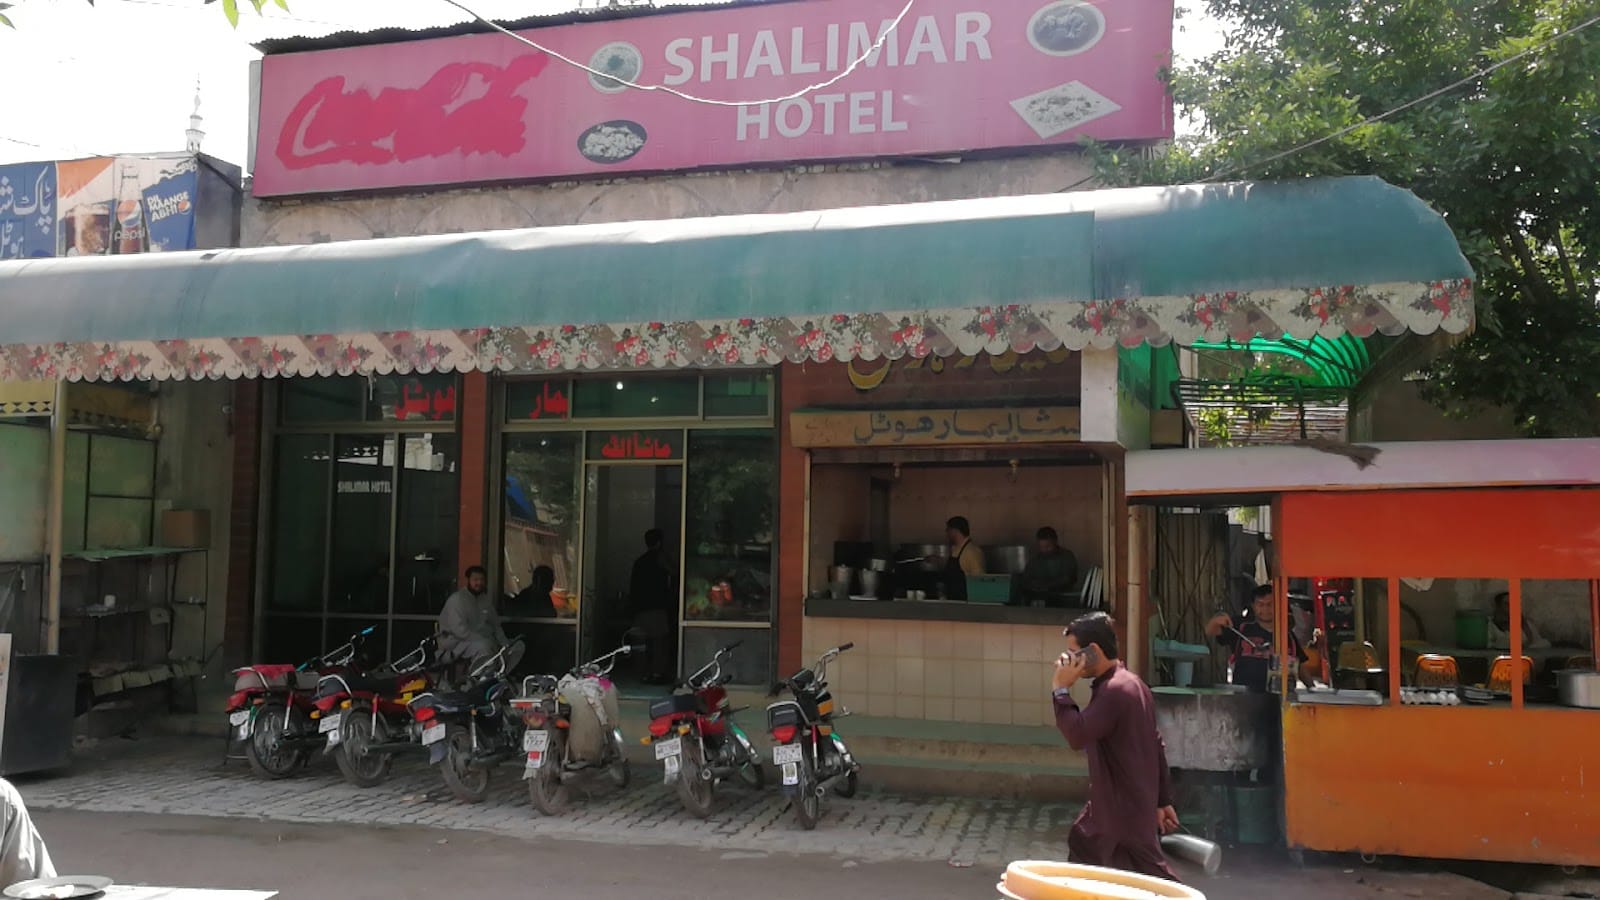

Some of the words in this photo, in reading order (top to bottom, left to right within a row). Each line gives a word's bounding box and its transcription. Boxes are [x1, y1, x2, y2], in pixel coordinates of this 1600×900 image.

[663, 11, 993, 86] SHALIMAR
[736, 89, 909, 142] HOTEL
[13, 165, 52, 235] پاک
[114, 228, 145, 241] pepsi
[371, 480, 391, 493] HOTEL
